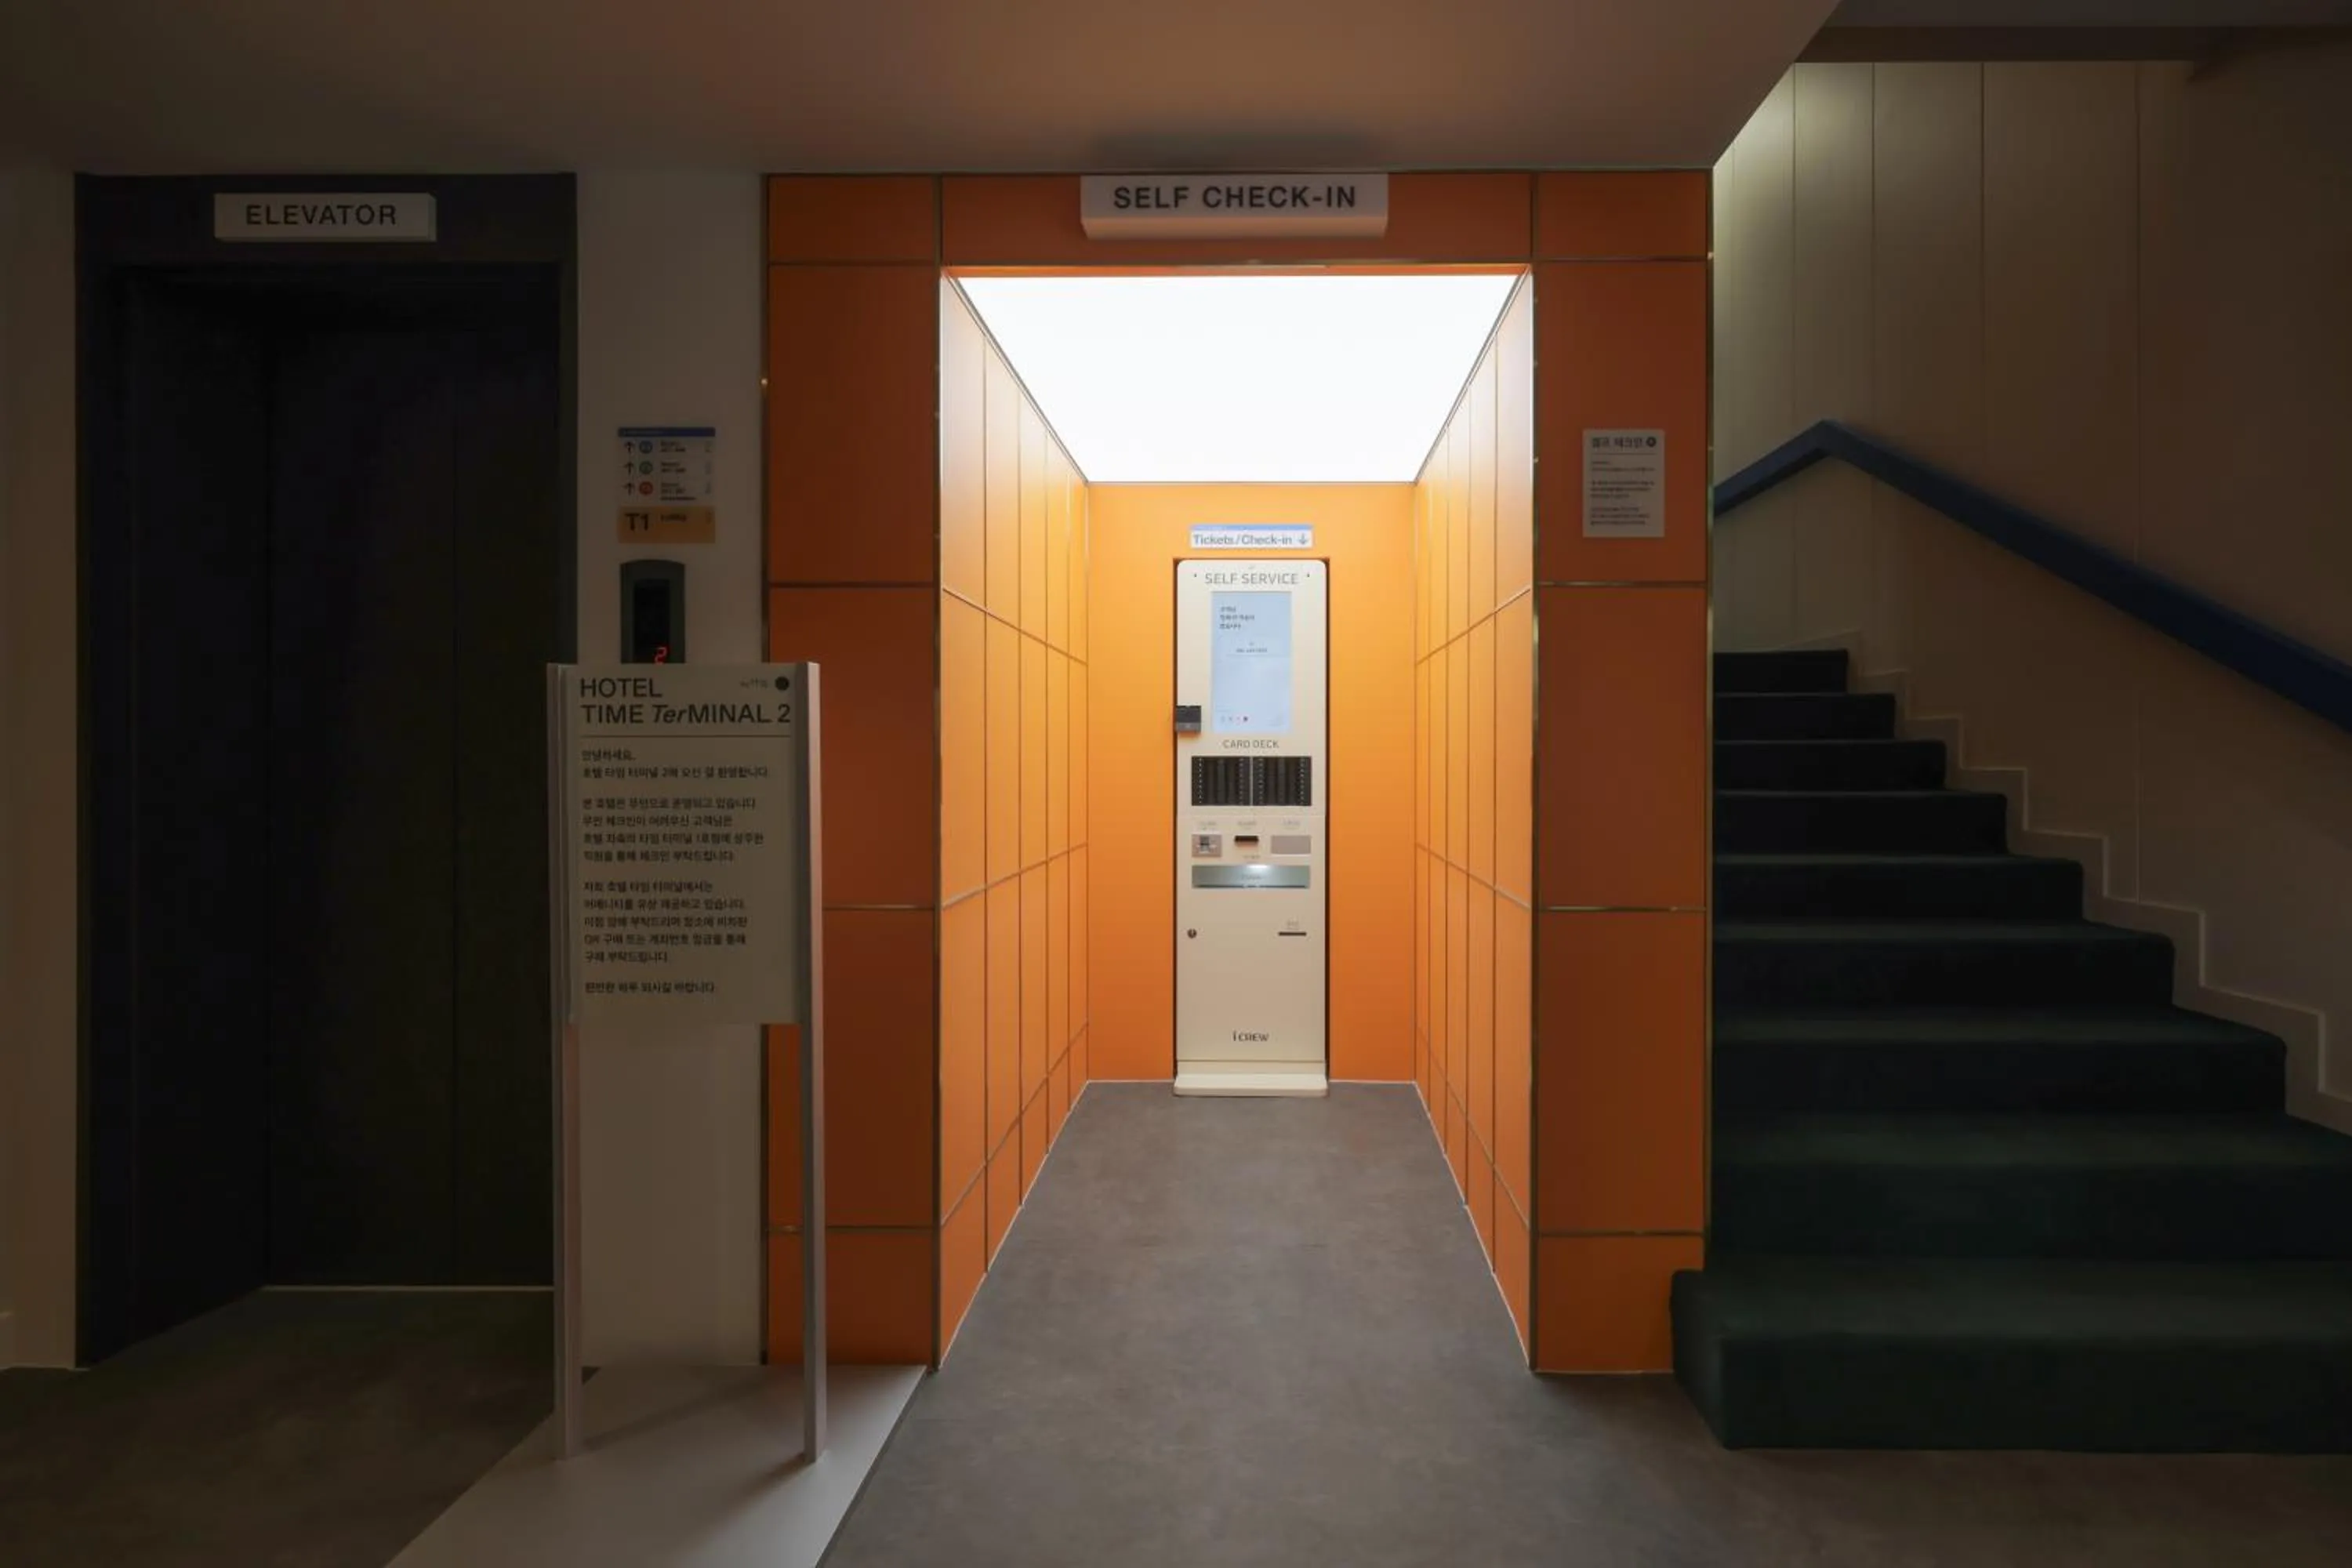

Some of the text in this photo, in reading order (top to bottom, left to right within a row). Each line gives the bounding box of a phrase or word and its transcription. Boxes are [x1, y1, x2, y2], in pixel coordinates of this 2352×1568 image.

[1112, 185, 1356, 209] SELF CHECK-IN
[245, 204, 397, 226] ELEVATOR
[625, 513, 648, 531] T1
[1204, 573, 1299, 585] SELF SERVICE
[580, 677, 663, 698] HOTEL
[581, 703, 791, 724] TIME TerMINAL 2
[1222, 739, 1280, 750] CARD DECK
